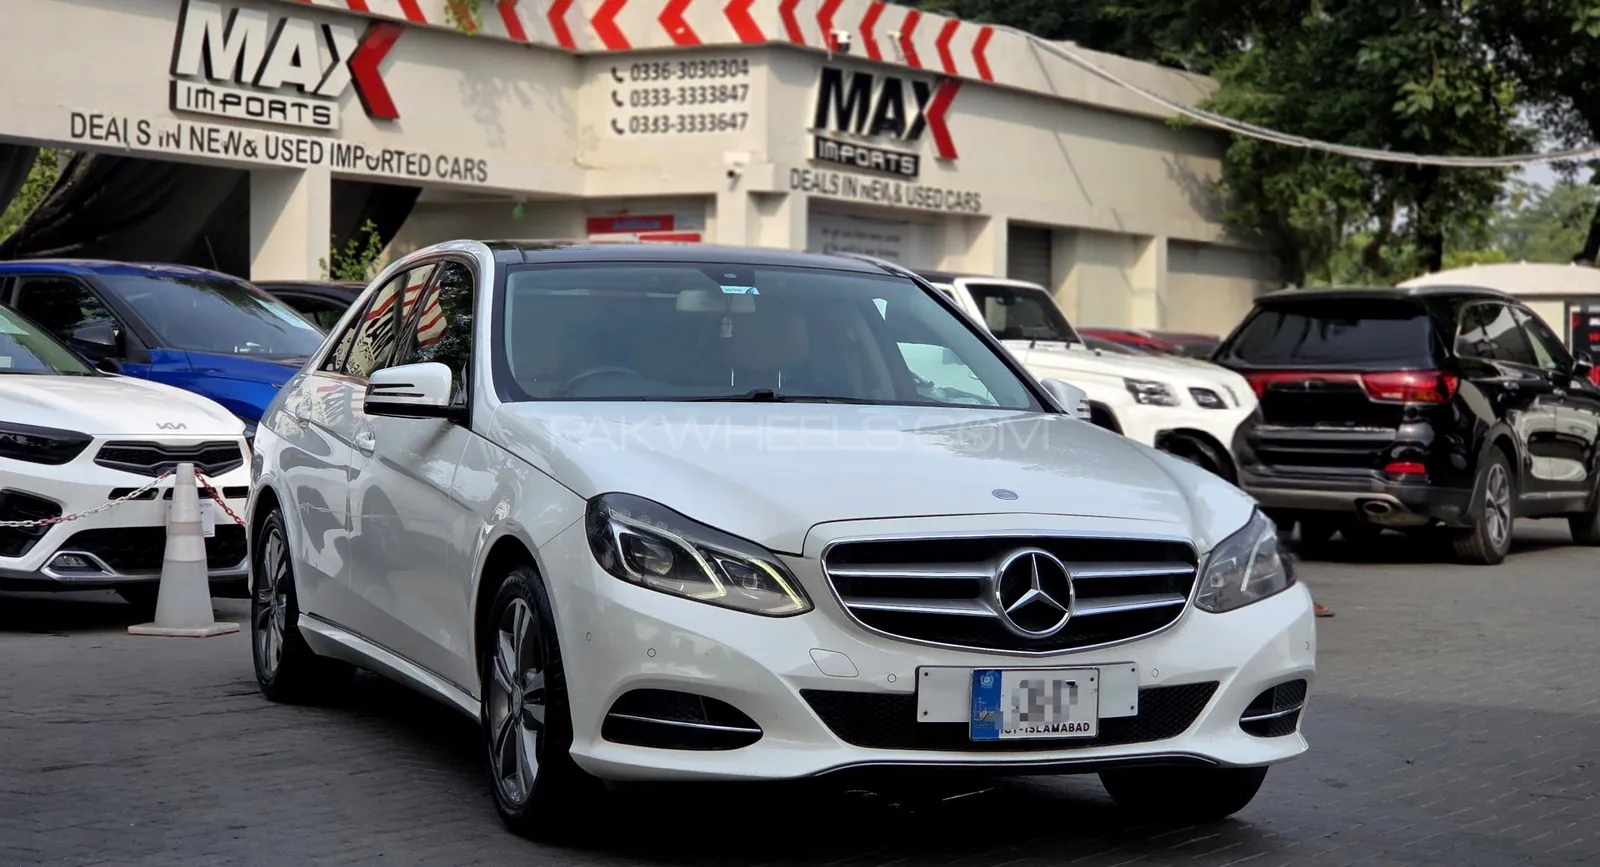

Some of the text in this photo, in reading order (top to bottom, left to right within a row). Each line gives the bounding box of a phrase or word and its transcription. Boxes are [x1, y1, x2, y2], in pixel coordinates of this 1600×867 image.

[170, 0, 404, 119] MAX
[630, 58, 749, 82] 0336-3030304
[186, 86, 331, 126] IMPORTS
[813, 66, 963, 160] MAX
[265, 134, 323, 165] USED
[435, 155, 488, 183] CARS
[817, 139, 916, 175] IMPORTS
[789, 167, 840, 196] DEALS
[905, 185, 943, 209] USED
[945, 189, 982, 213] CARS
